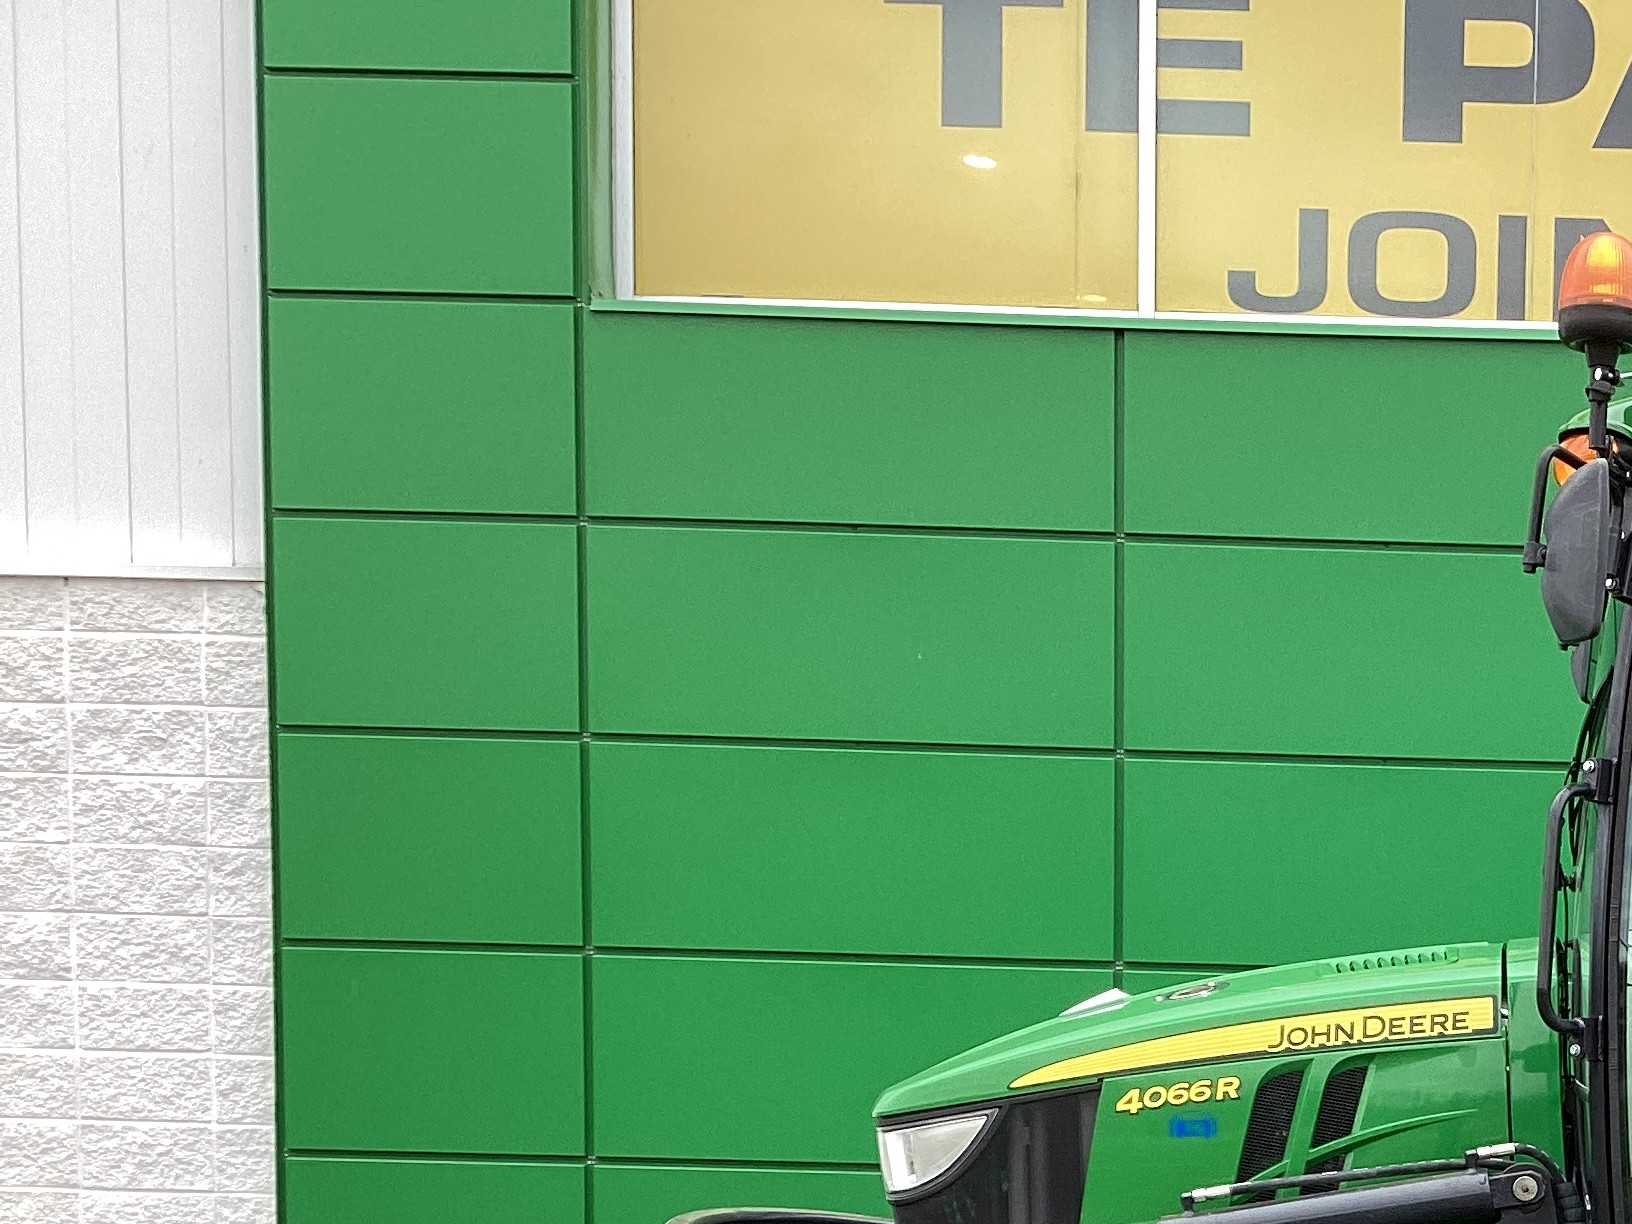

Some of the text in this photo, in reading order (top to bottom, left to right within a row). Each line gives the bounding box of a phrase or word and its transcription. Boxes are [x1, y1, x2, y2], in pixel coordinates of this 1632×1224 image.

[884, 0, 1251, 137] TE
[1267, 1011, 1471, 1050] JOHN DEERE
[1115, 1076, 1242, 1115] 4066R
